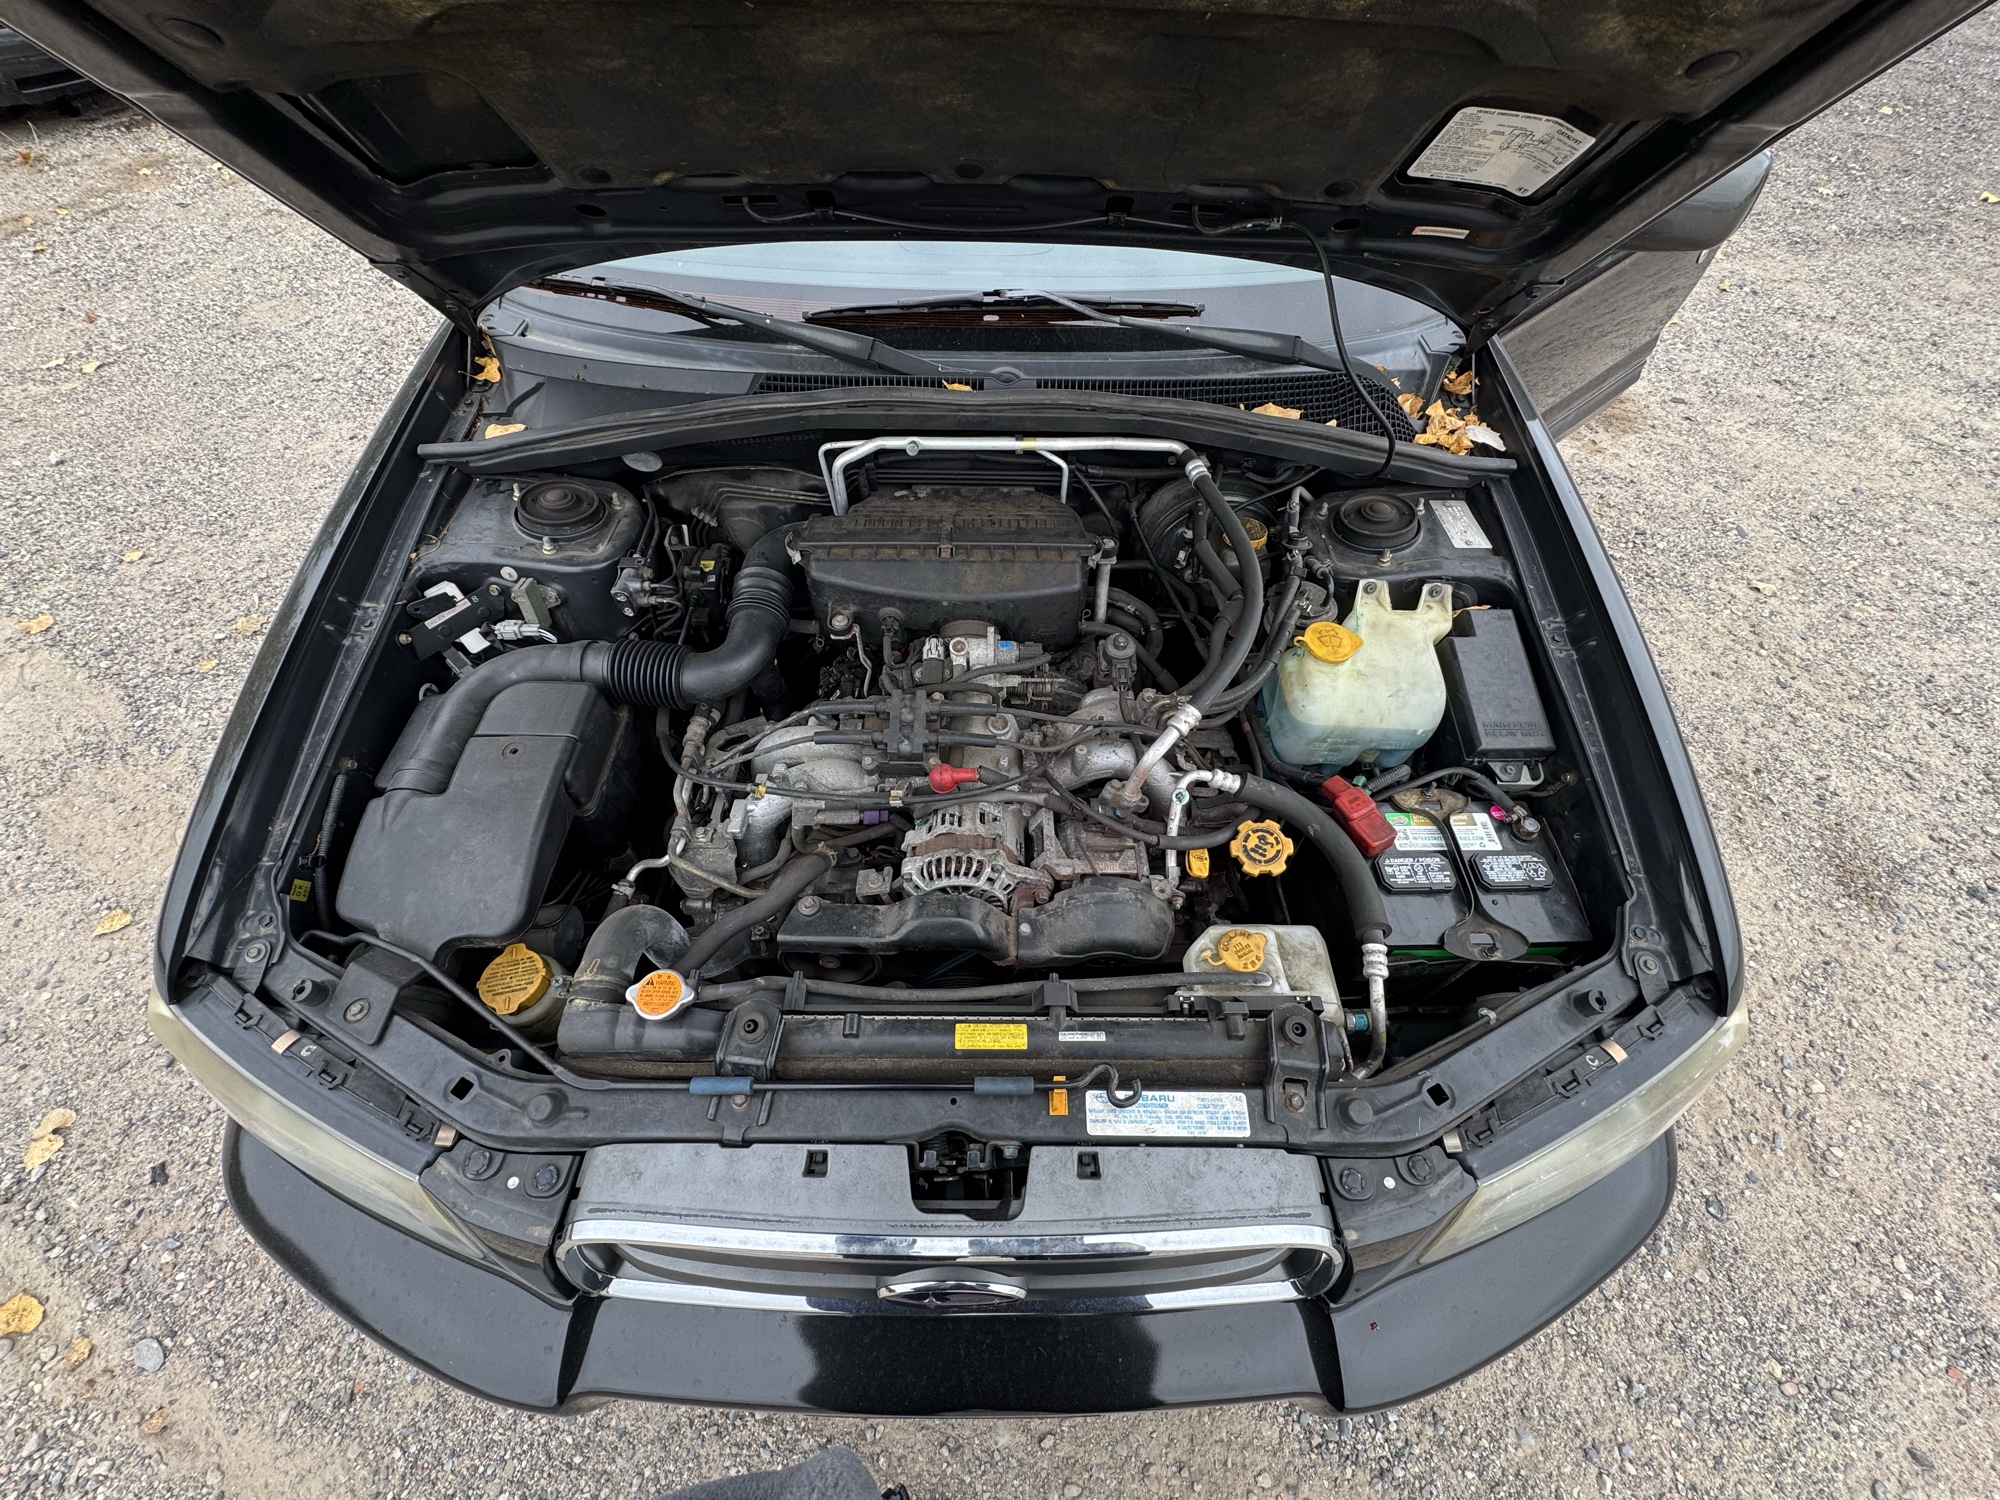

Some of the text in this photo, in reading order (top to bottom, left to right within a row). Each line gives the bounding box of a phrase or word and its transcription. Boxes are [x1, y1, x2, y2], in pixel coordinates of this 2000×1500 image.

[1497, 111, 1520, 119] EMISSION
[1521, 114, 1542, 122] CONTROL
[1544, 118, 1575, 133] INFORMATION
[1556, 129, 1582, 145] CATALYST
[1125, 1093, 1175, 1102] SBARU
